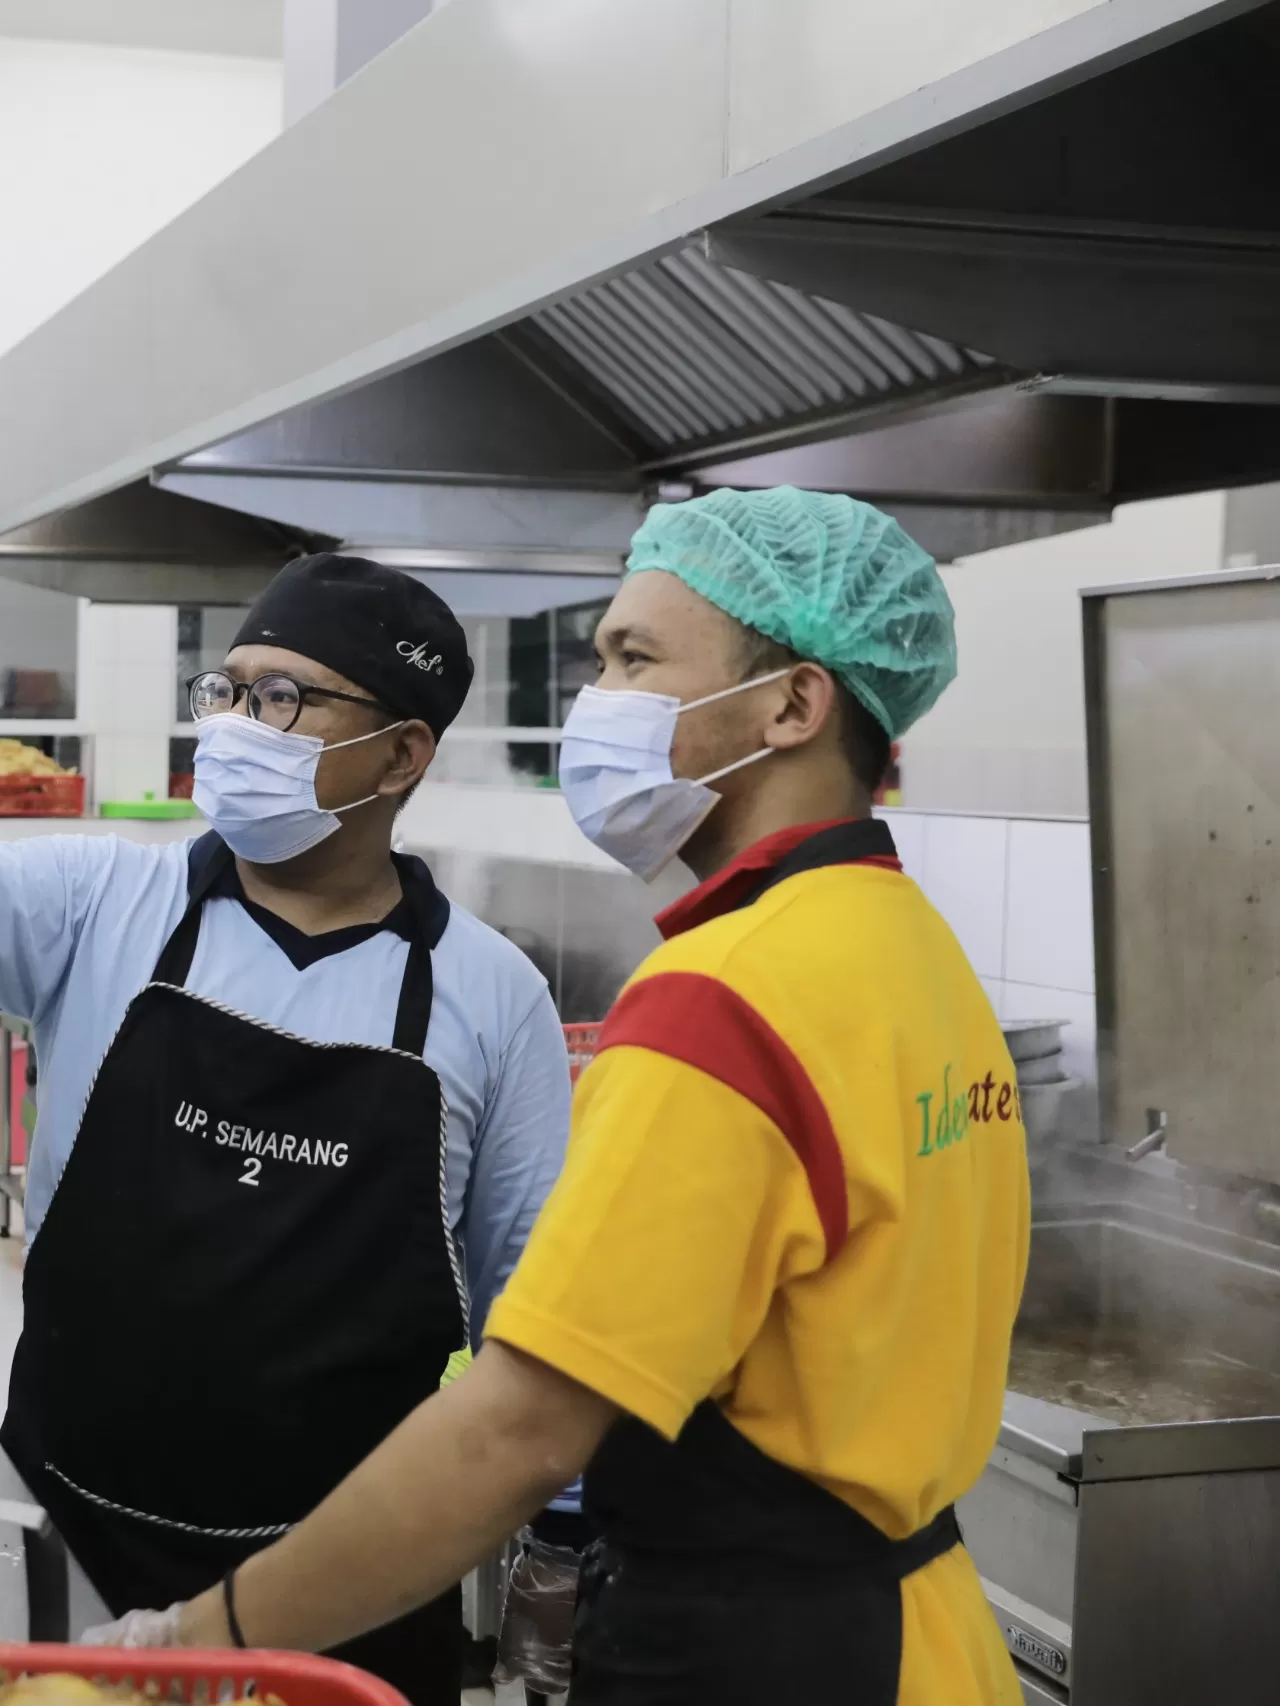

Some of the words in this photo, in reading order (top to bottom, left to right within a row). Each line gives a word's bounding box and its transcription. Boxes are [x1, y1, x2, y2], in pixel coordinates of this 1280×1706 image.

[175, 1101, 208, 1138] U.P.
[215, 1121, 349, 1167] SEMARANG
[238, 1158, 262, 1186] 2
